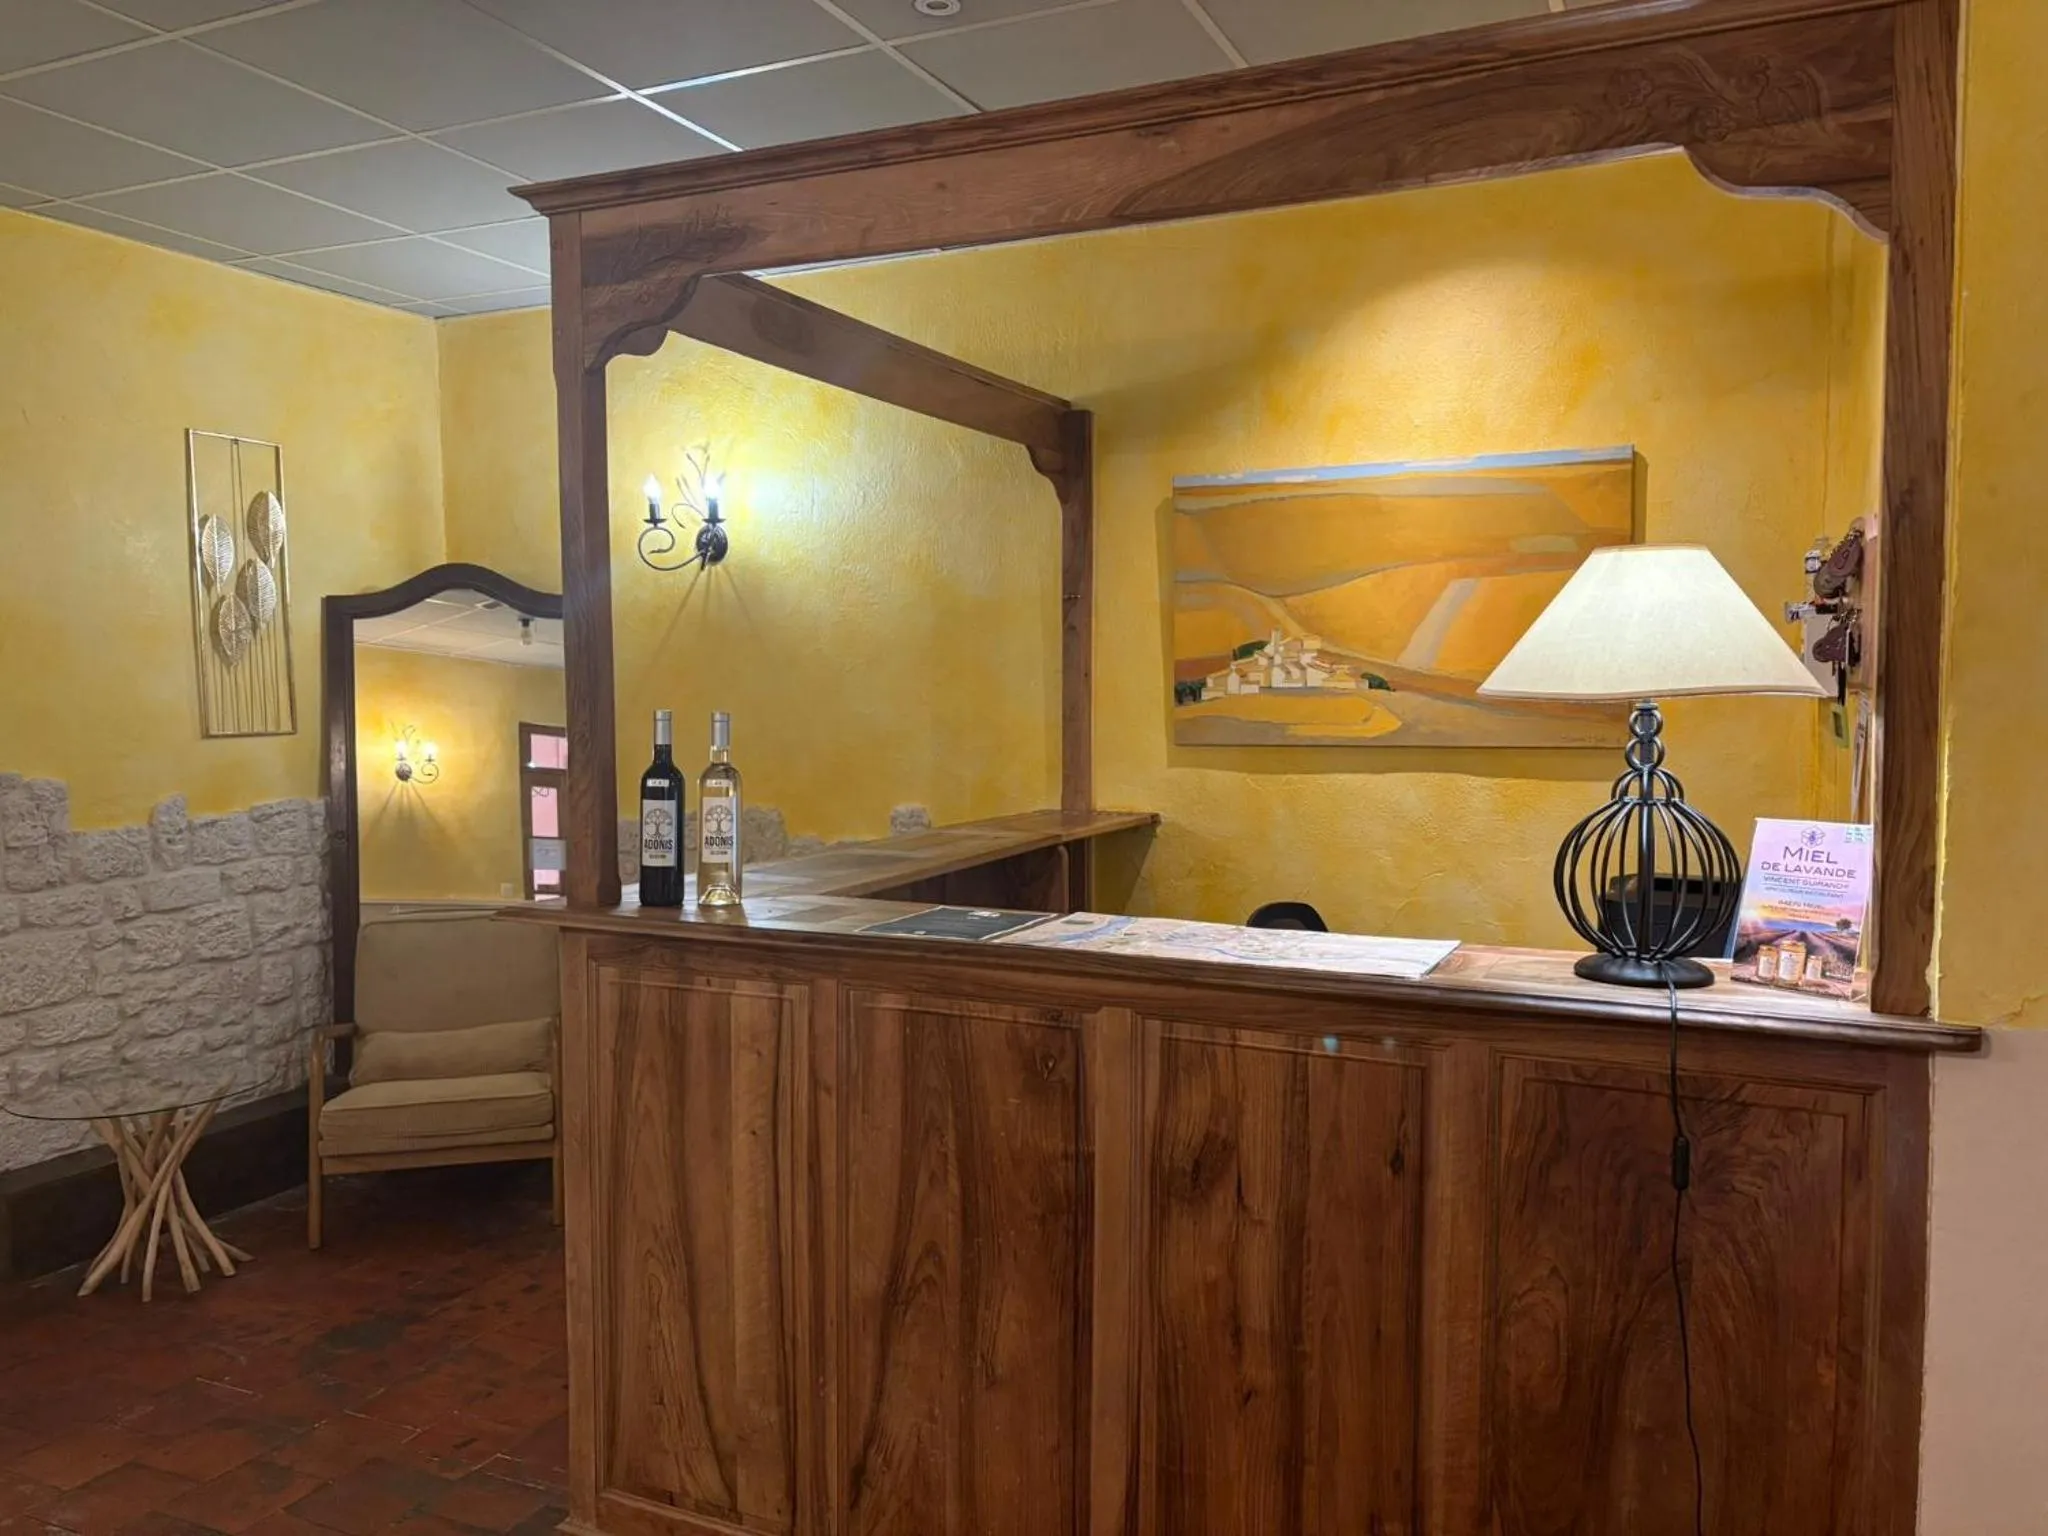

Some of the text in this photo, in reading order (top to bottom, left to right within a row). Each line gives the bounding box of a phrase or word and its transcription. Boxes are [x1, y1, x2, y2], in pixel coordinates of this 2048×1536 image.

[644, 838, 673, 850] ADONIS
[704, 836, 733, 847] ADONIS
[1783, 846, 1838, 864] MIEL
[1761, 861, 1857, 879] DE LAVANDE
